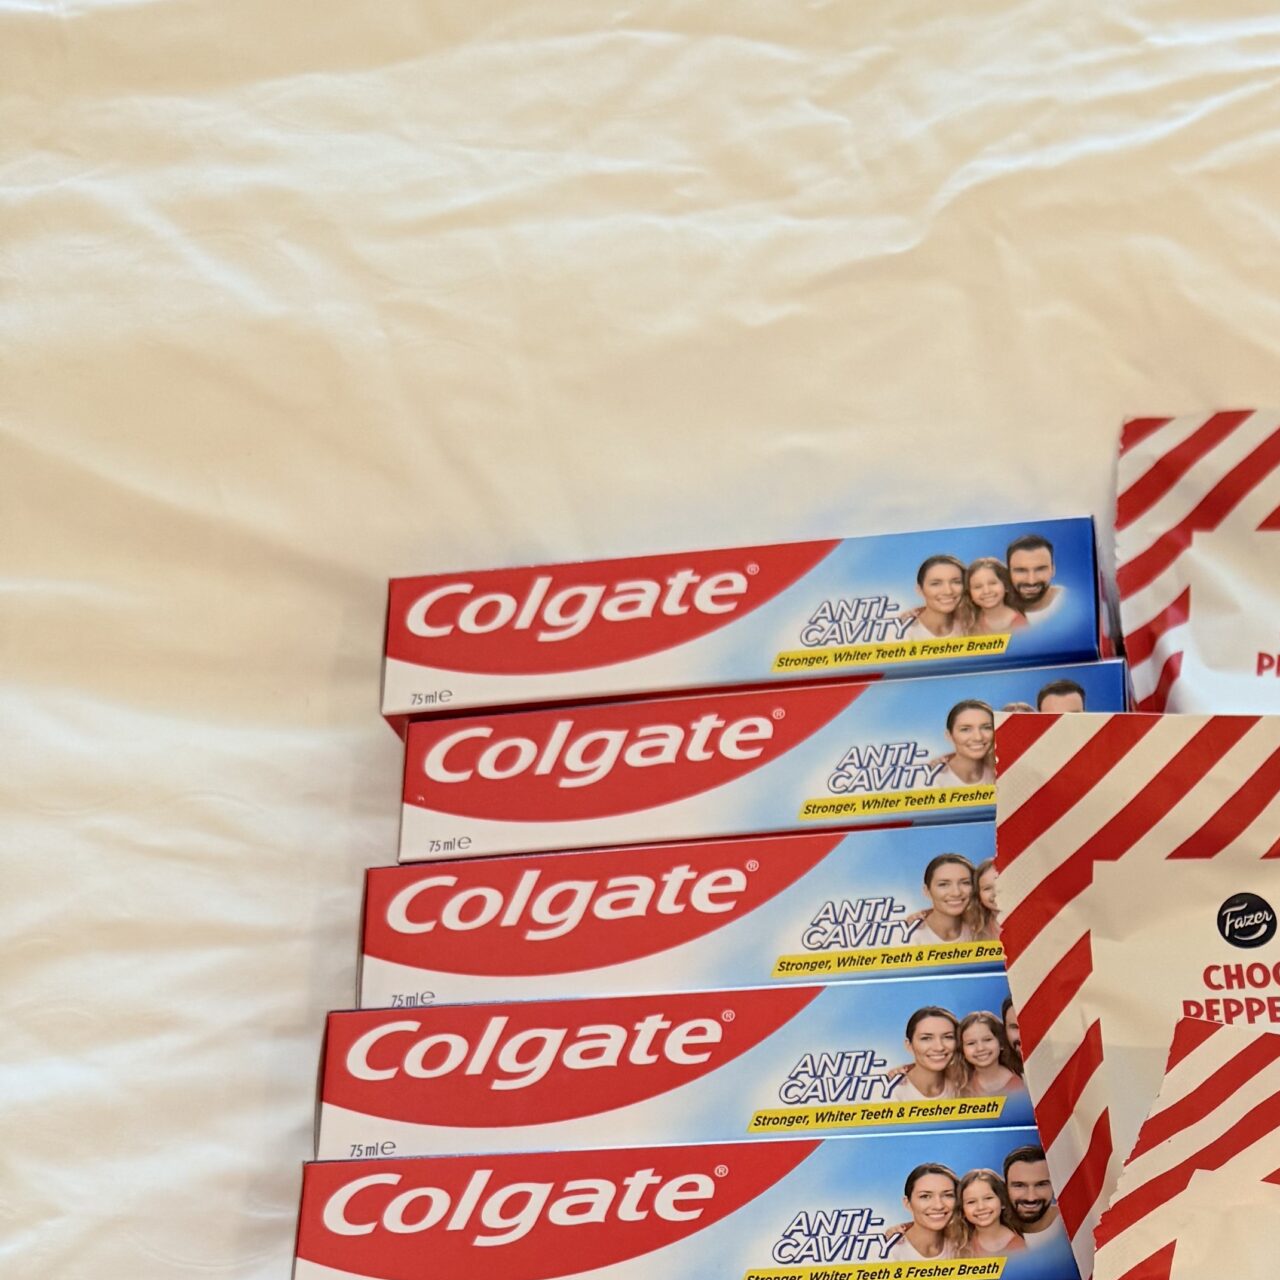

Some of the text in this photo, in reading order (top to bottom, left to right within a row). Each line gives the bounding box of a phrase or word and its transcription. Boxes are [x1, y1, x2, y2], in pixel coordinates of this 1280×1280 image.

[808, 596, 900, 624] ANTI-
[800, 616, 918, 647] CAVITY
[776, 638, 1004, 668] Stronger, Whiter Teeth & Fresher Breath
[411, 693, 423, 705] 75
[836, 742, 928, 770] ANTI-
[827, 762, 945, 793] CAVITY
[803, 789, 995, 815] Stronger, Whiter Teeth & Fresher
[429, 840, 441, 852] 75
[810, 897, 905, 925] ANTI-
[801, 918, 922, 950] CAVITY
[777, 942, 1005, 972] Stronger, Whiter Teeth & Fresher Brea
[391, 995, 404, 1007] 75
[788, 1050, 887, 1079] ANTI-
[778, 1073, 902, 1104] CAVITY
[753, 1100, 999, 1127] Stronger, Whiter Teeth & Fresher Breath
[350, 1145, 362, 1157] 75
[783, 1208, 884, 1238] ANTI-
[772, 1232, 901, 1264] CAVITY
[856, 1267, 890, 1280] Teeth
[893, 1267, 903, 1279] &
[905, 1265, 955, 1278] Fresher
[957, 1261, 999, 1276] Breath
